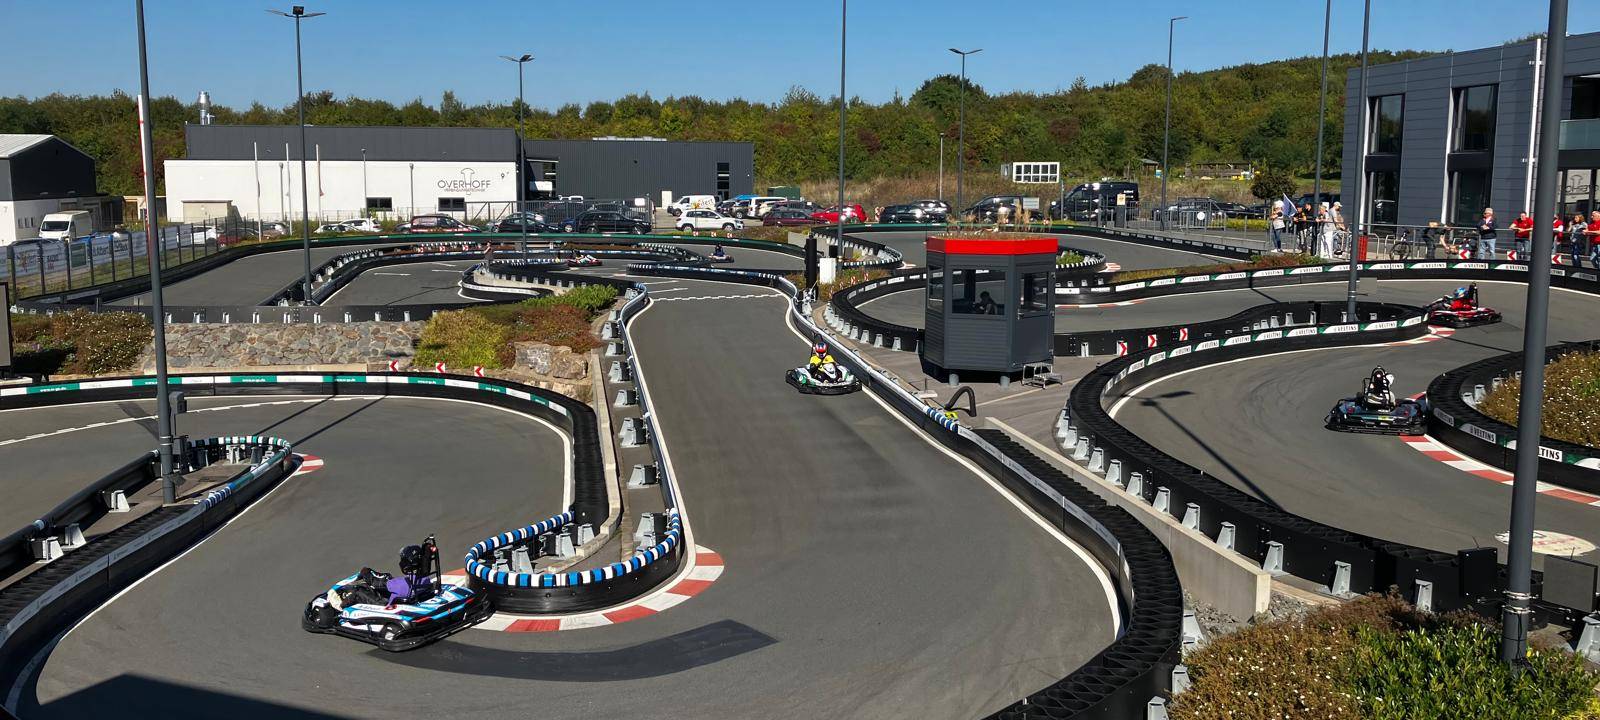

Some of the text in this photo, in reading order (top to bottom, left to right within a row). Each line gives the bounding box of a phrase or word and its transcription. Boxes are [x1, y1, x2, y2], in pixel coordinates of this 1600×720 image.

[437, 179, 492, 189] OVERHOFF
[1473, 426, 1495, 442] VELTINS
[1537, 446, 1560, 460] LTINS
